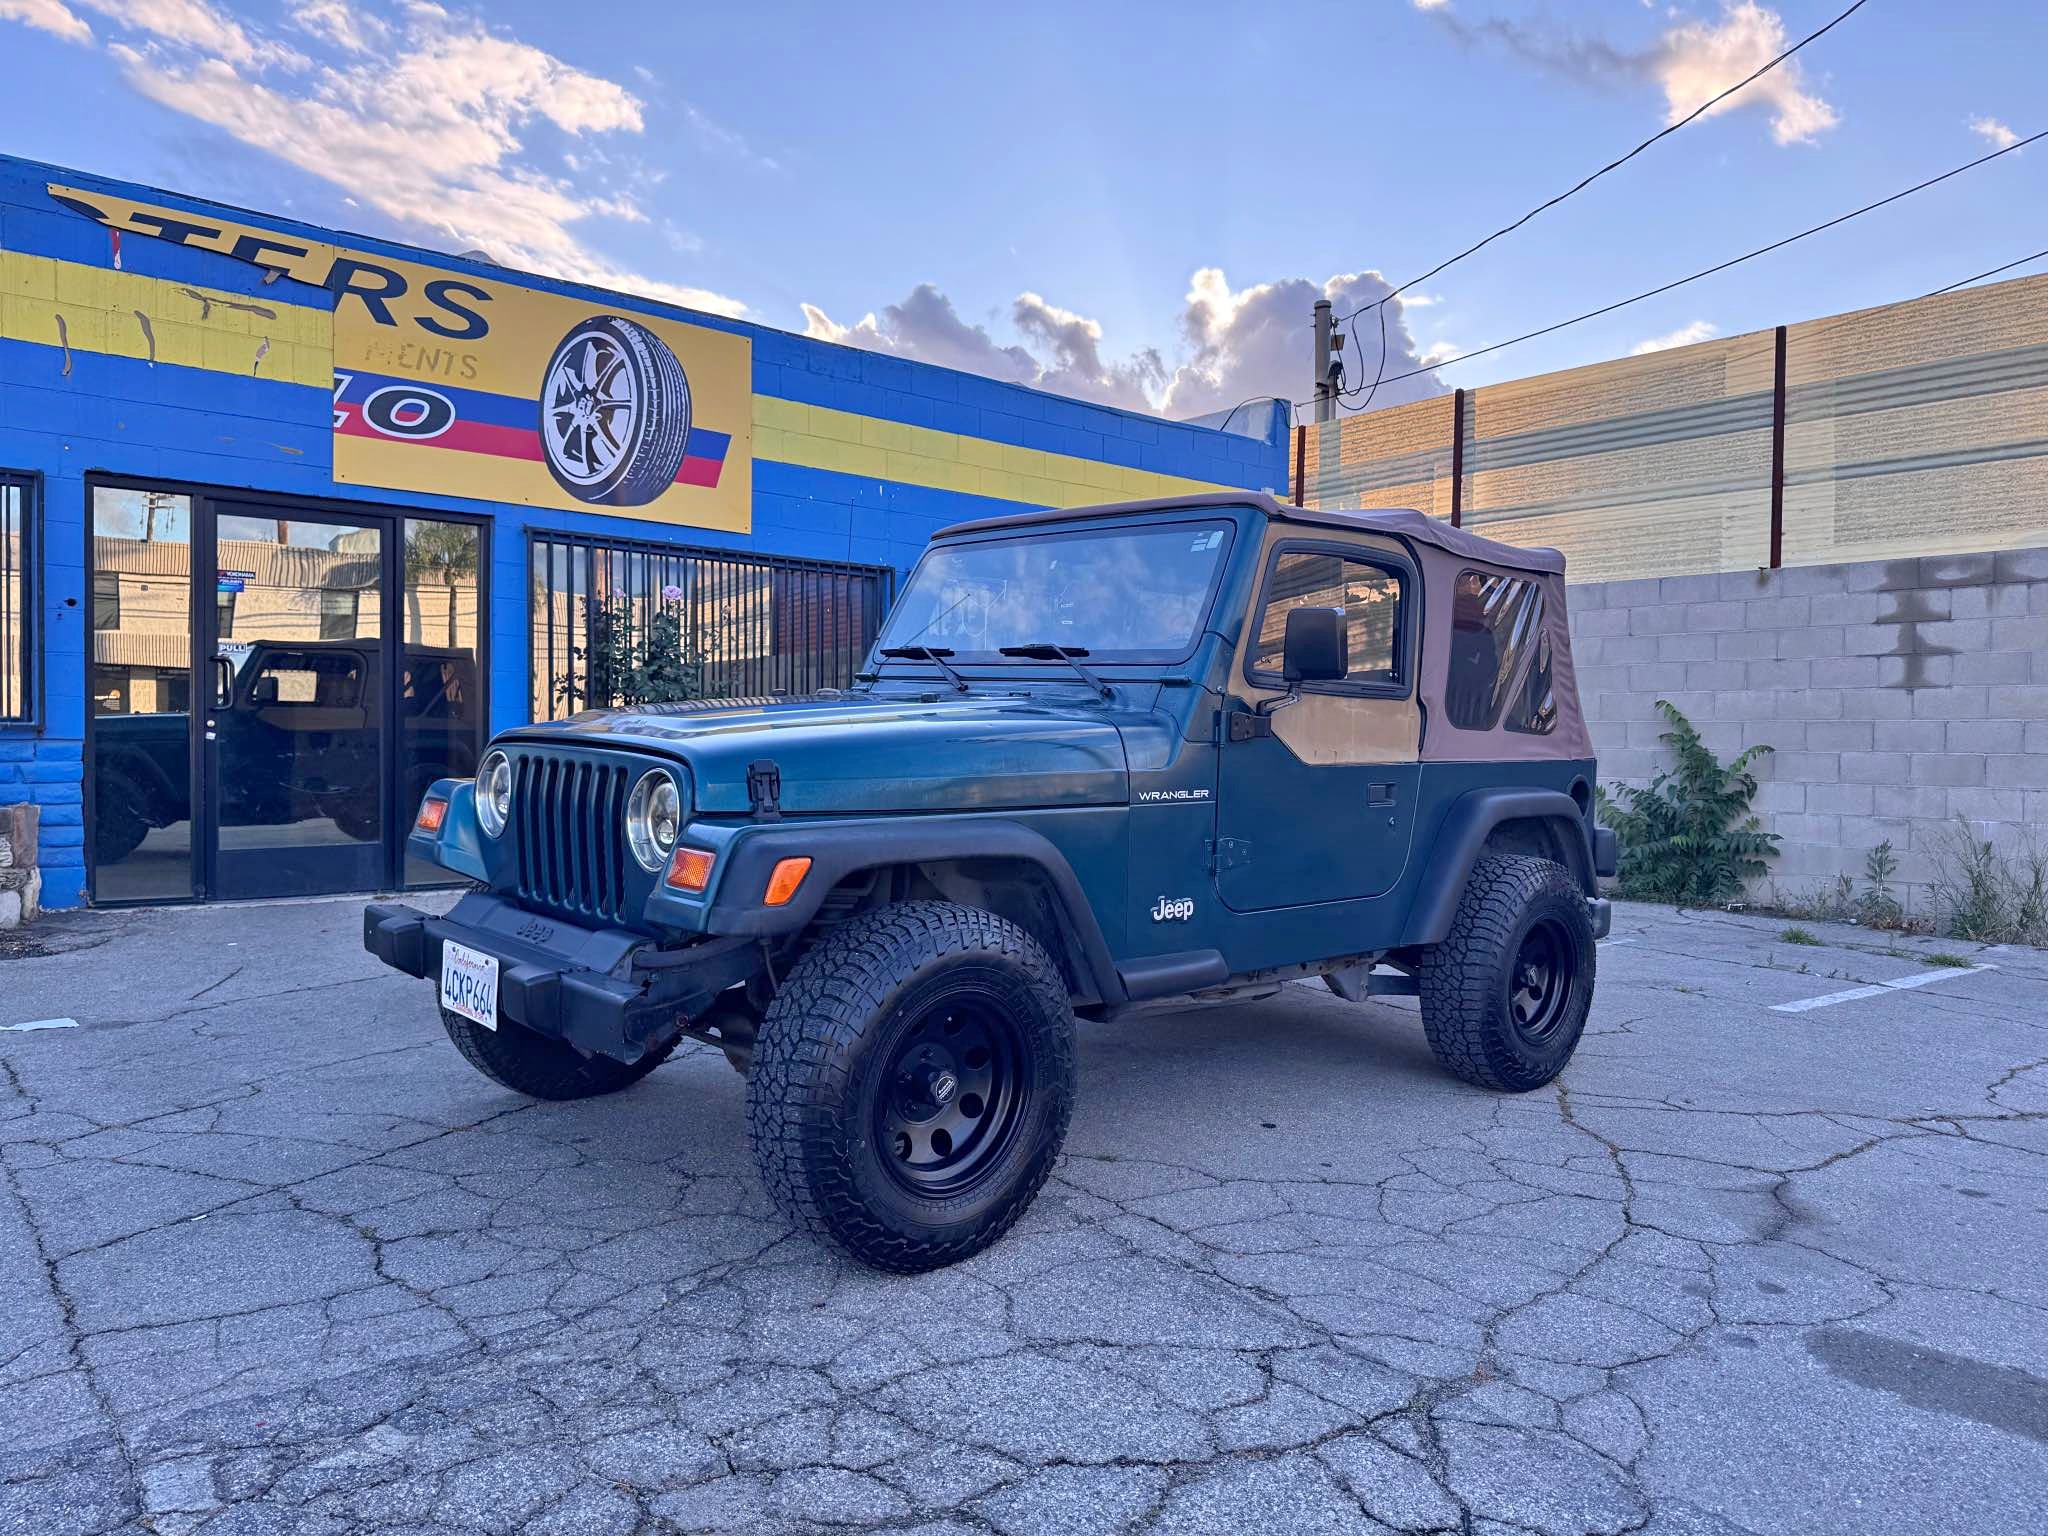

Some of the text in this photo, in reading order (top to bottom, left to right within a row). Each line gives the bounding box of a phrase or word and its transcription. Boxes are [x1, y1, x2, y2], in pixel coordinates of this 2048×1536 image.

[51, 193, 494, 340] TERS
[219, 643, 246, 652] PULL
[1138, 789, 1210, 801] WRANGLER
[1151, 895, 1194, 921] Jeep
[444, 966, 493, 1020] 4CKP664
